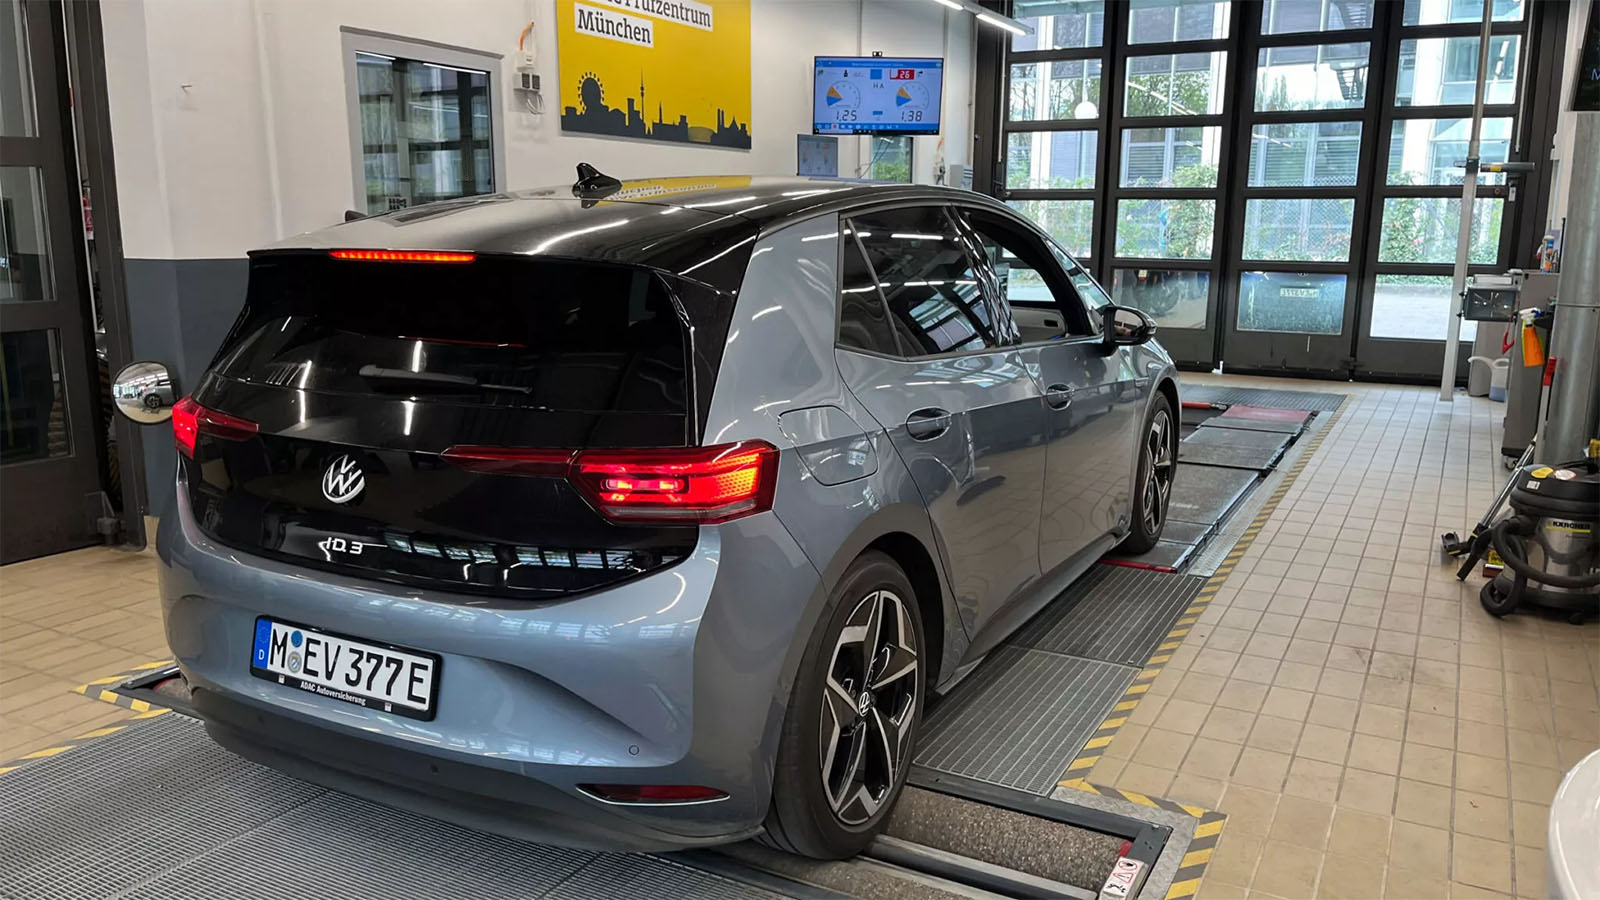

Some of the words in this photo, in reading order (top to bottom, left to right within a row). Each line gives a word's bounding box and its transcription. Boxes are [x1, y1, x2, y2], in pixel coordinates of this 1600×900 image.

[578, 9, 651, 43] München
[900, 70, 910, 79] 26
[258, 649, 265, 661] D
[269, 628, 288, 668] M
[302, 637, 341, 681] EV
[300, 680, 316, 692] ADAC
[316, 685, 366, 706] Autoversicherung
